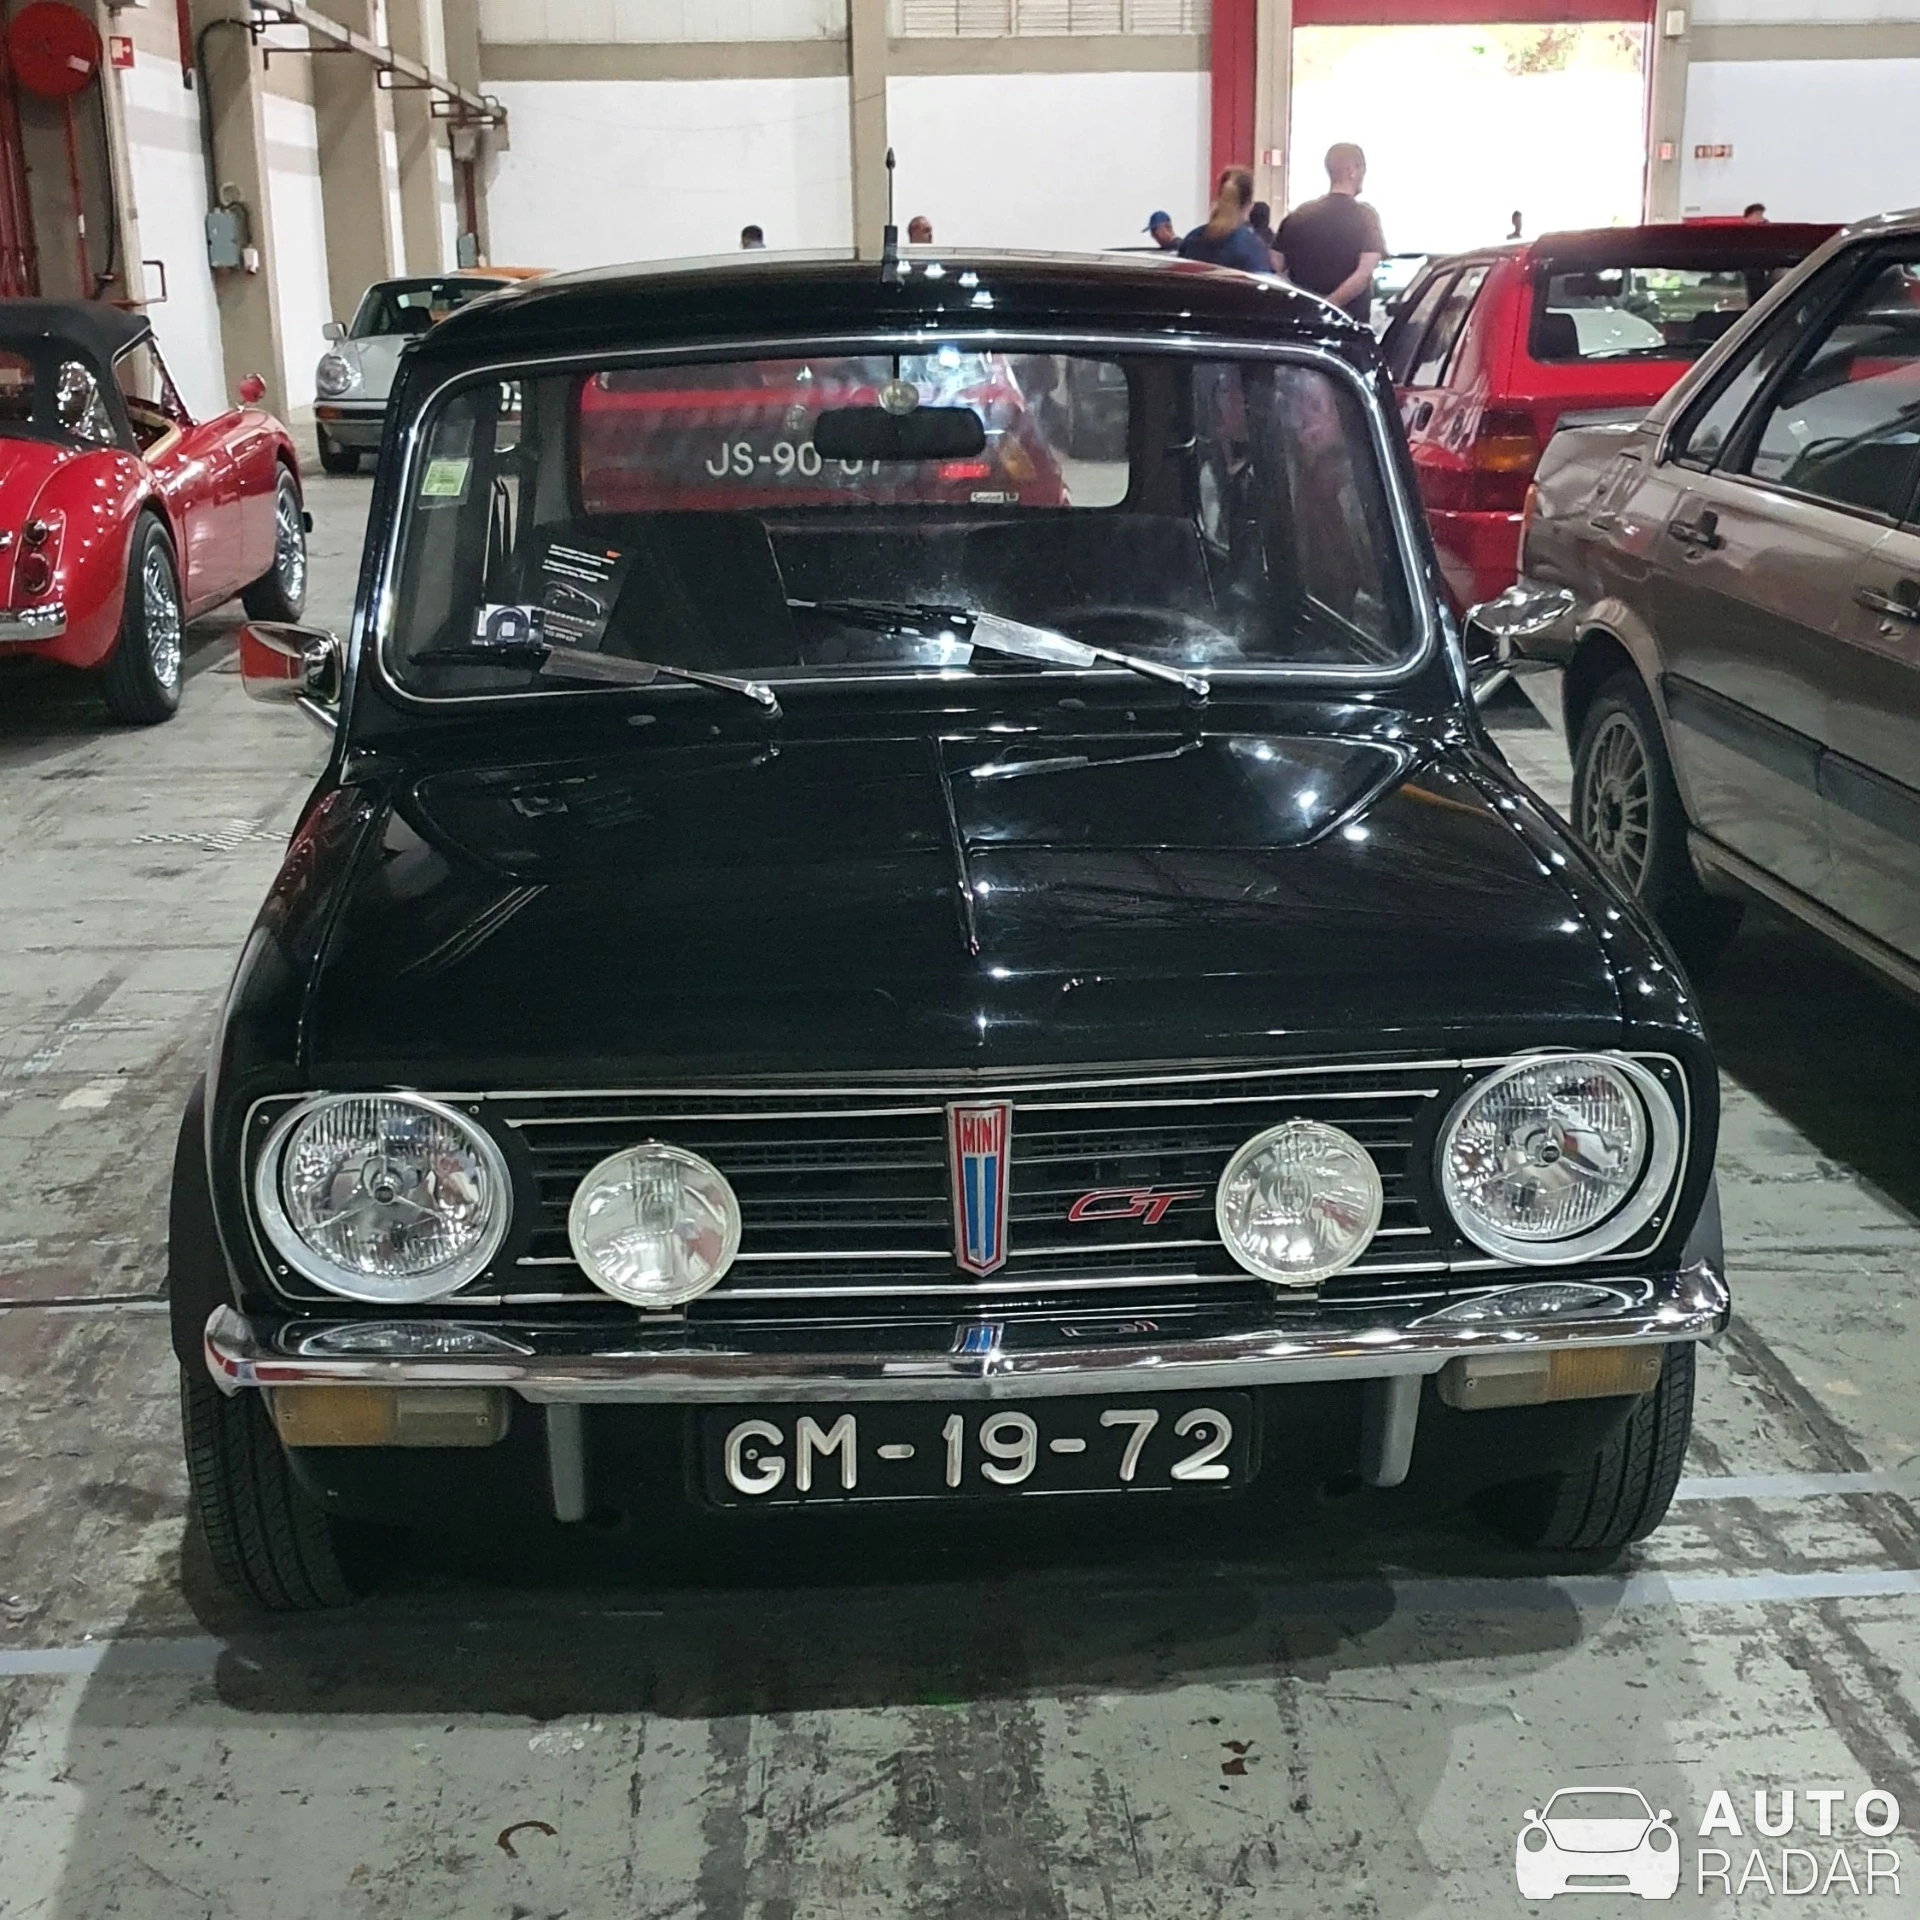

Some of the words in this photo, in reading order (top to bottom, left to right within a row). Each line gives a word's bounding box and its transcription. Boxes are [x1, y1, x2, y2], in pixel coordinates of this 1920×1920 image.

[961, 1112, 1000, 1153] MINI
[1068, 1187, 1206, 1225] GT
[724, 1407, 1233, 1495] GM-19-72
